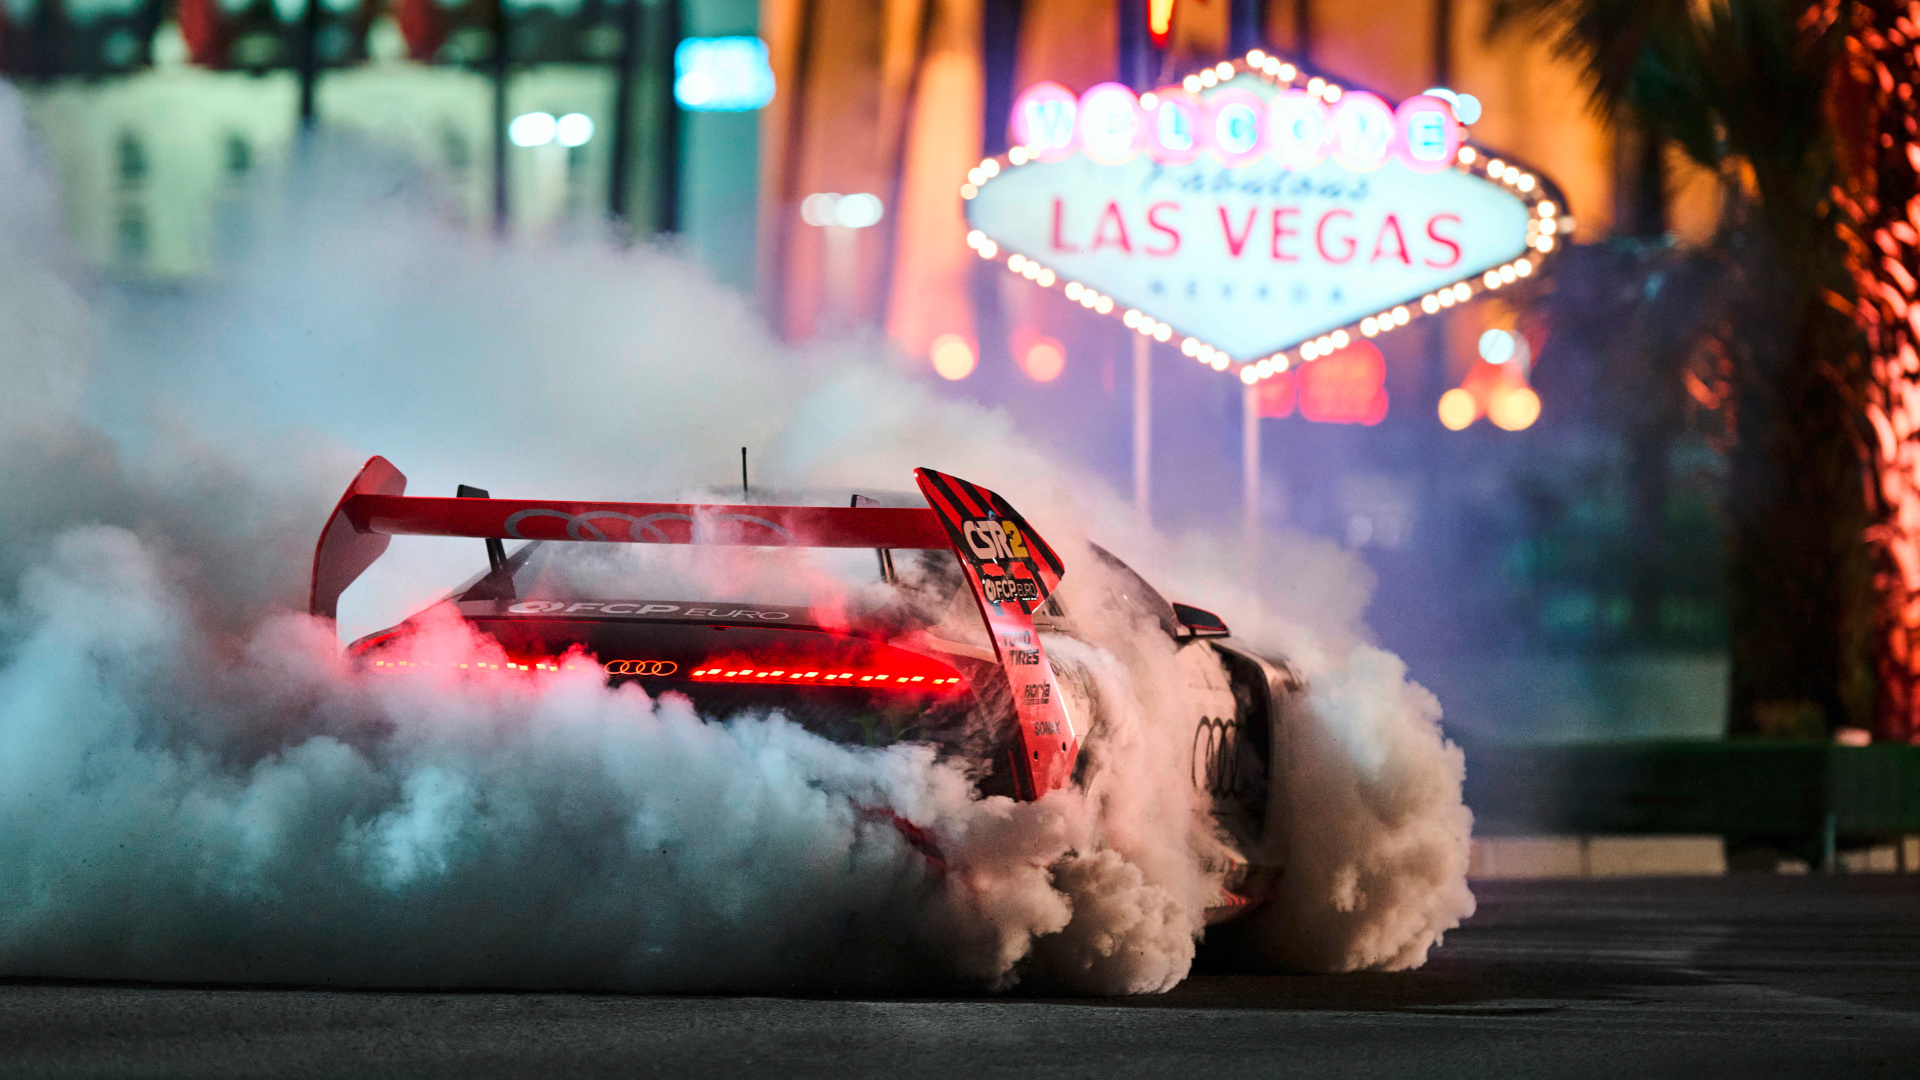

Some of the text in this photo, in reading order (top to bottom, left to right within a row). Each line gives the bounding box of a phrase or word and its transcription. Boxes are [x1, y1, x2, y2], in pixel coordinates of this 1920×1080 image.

[1024, 99, 1448, 173] WELCOME
[1050, 198, 1465, 269] LAS VEGAS
[963, 520, 1030, 560] CSR2
[995, 580, 1016, 598] FCP
[564, 602, 789, 620] FCP EURO
[1009, 649, 1039, 665] TIRES
